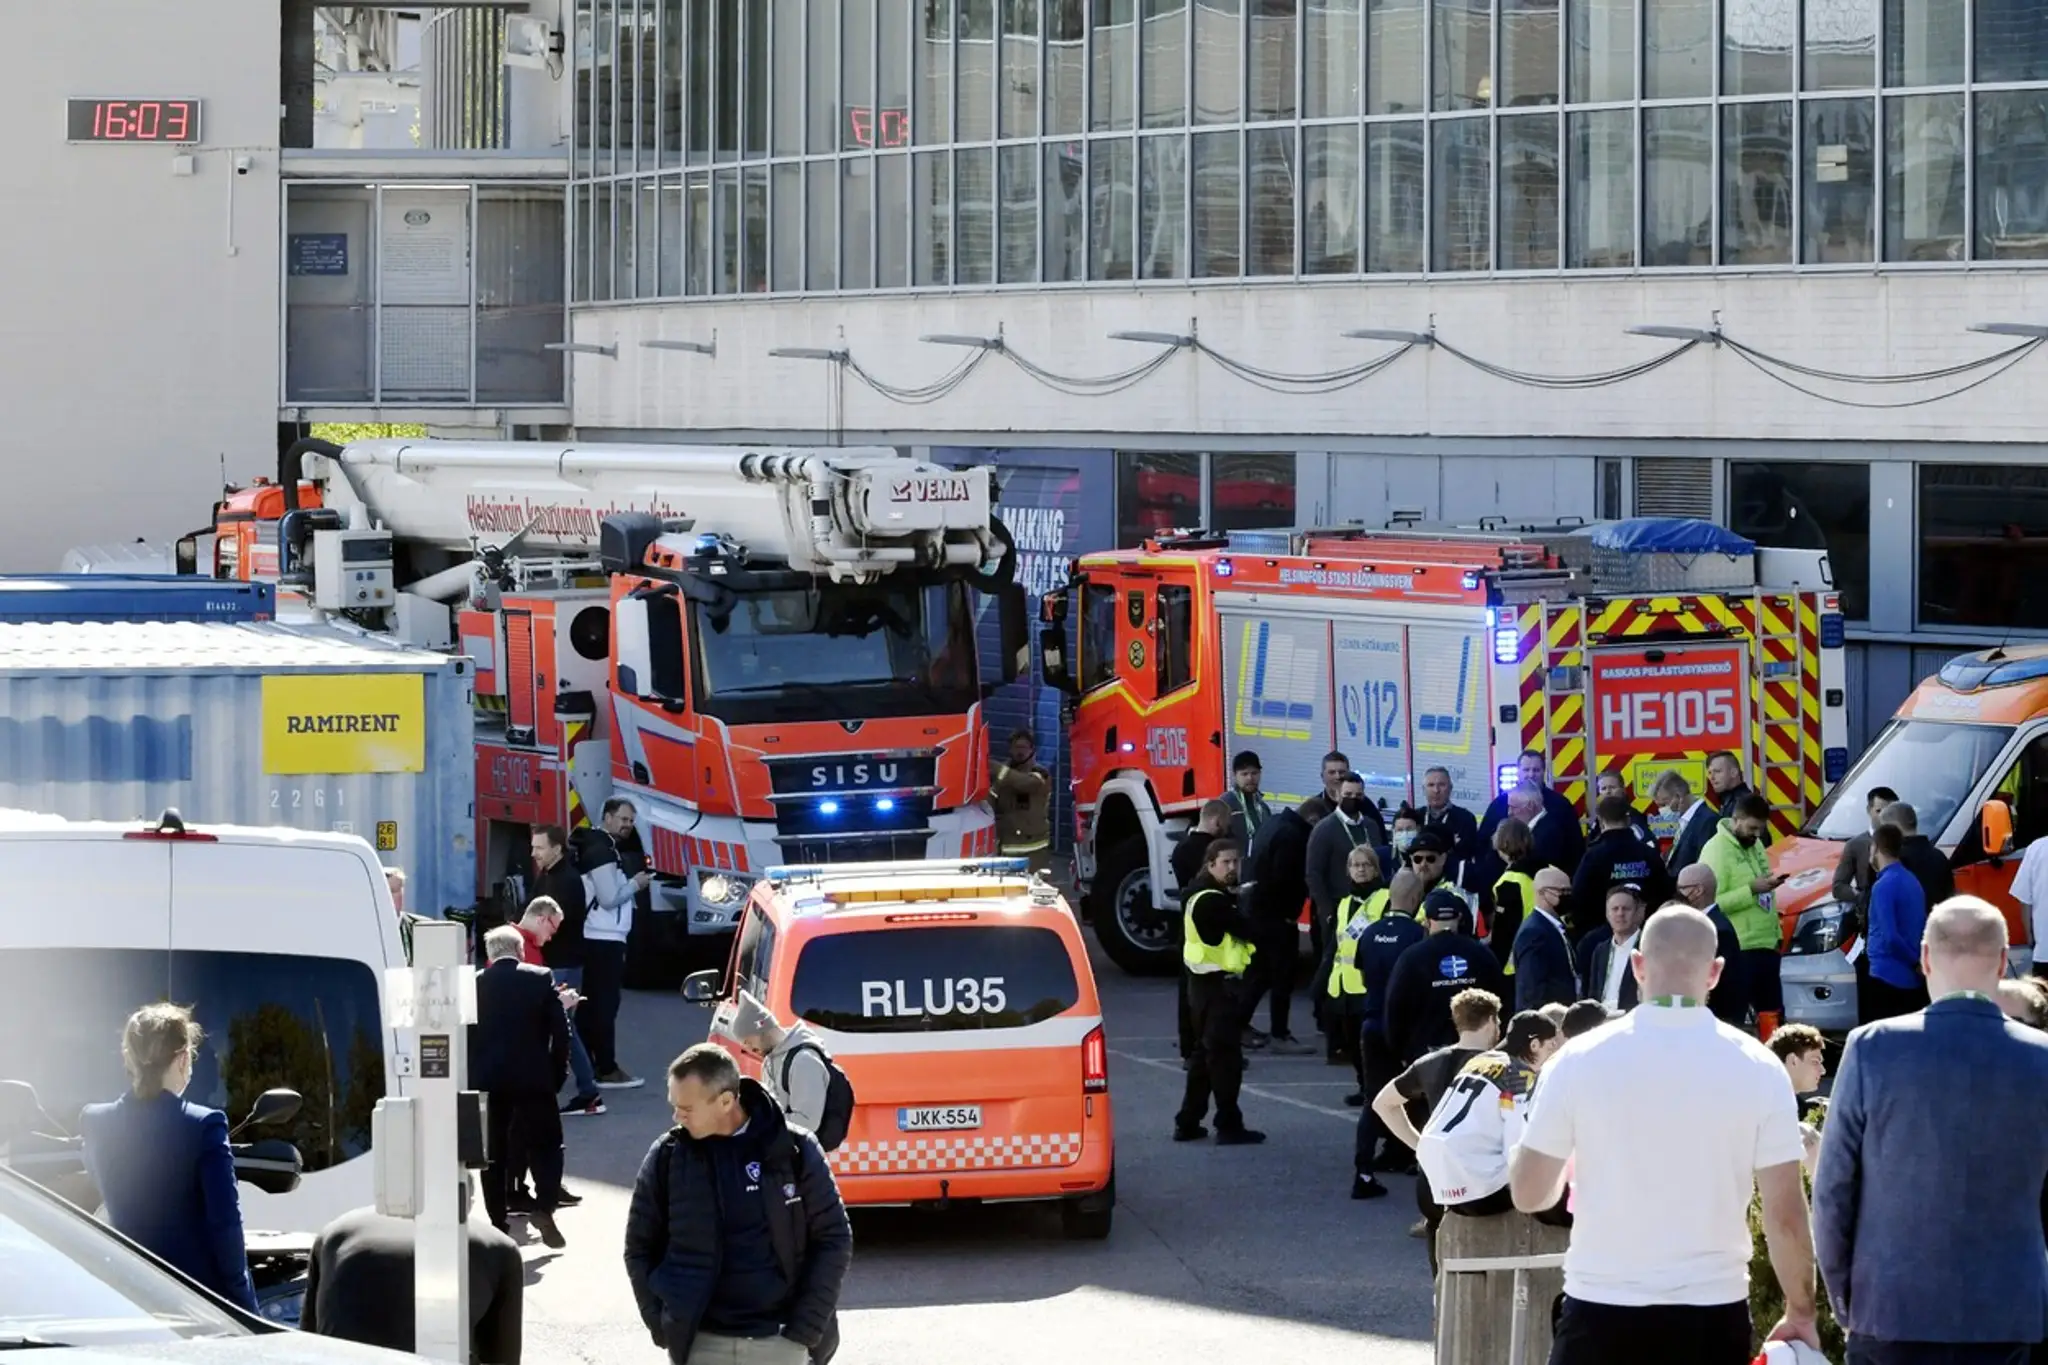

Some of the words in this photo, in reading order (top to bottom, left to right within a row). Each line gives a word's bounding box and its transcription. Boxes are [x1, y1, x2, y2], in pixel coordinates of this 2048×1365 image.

[93, 102, 188, 139] 16:03
[915, 479, 970, 502] VEMA
[1002, 507, 1065, 553] MAKING
[287, 714, 400, 734] RAMIRENT
[1364, 679, 1400, 748] 112
[1602, 688, 1734, 740] HE105
[1146, 726, 1188, 767] HE105
[811, 763, 898, 786] SISU
[861, 976, 1007, 1018] RLU35
[910, 1108, 978, 1126] JKK-554
